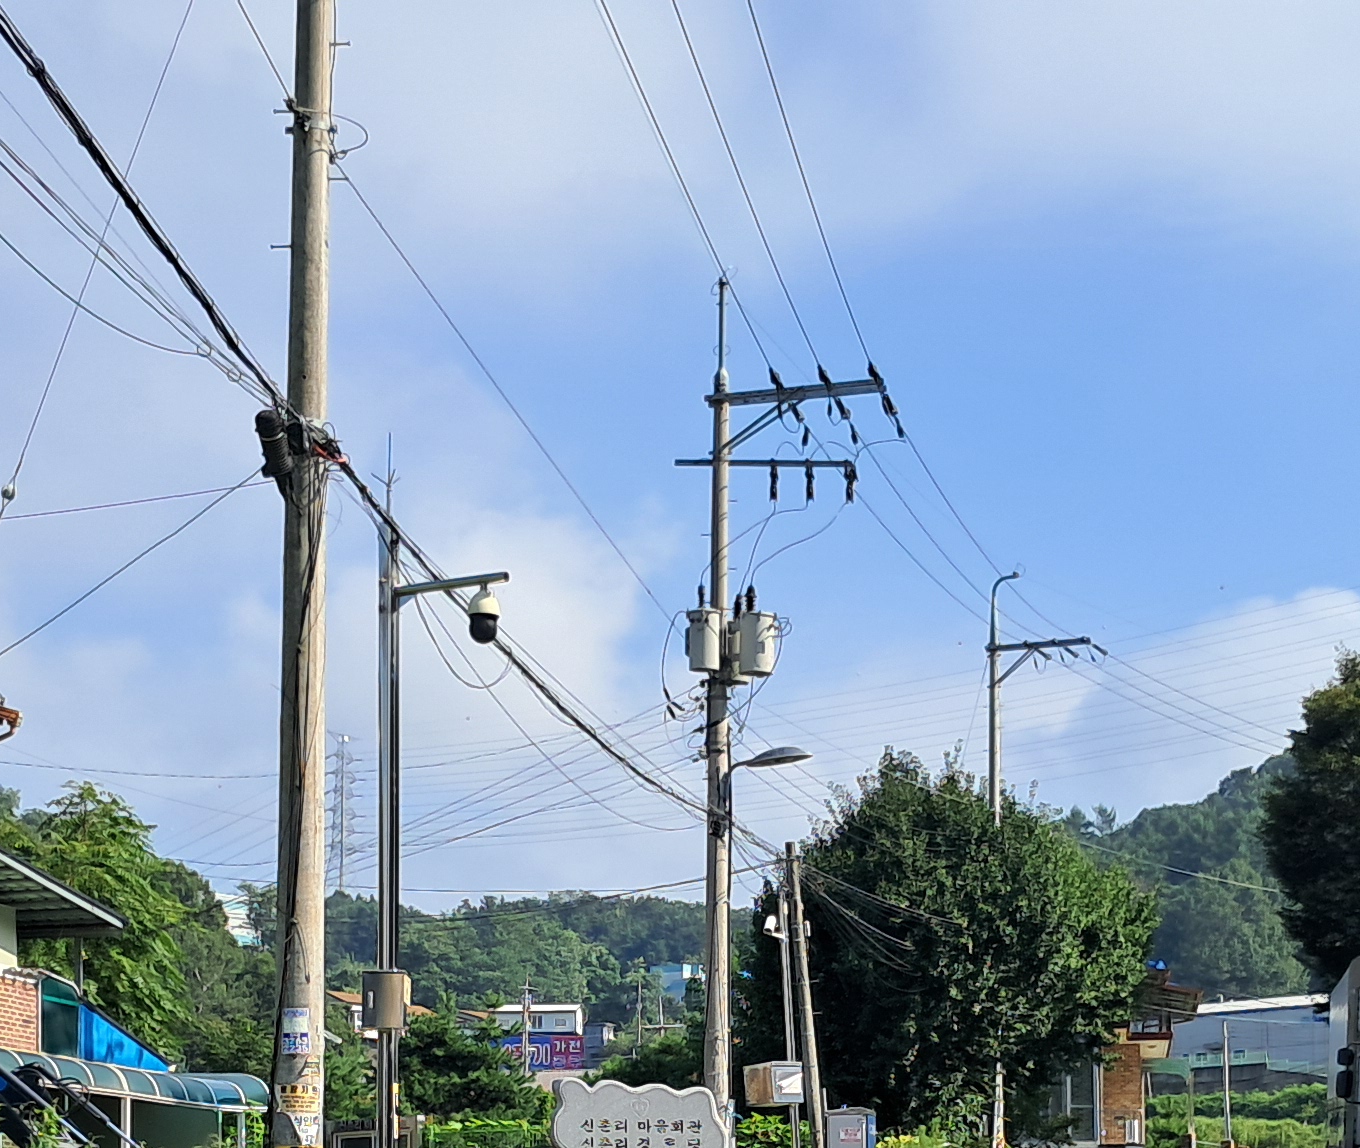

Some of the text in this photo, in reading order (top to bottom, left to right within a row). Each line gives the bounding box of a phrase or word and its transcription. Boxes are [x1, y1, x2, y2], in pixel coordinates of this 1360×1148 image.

[553, 1040, 582, 1053] 가전
[580, 1118, 702, 1134] 신촌리 마을회관
